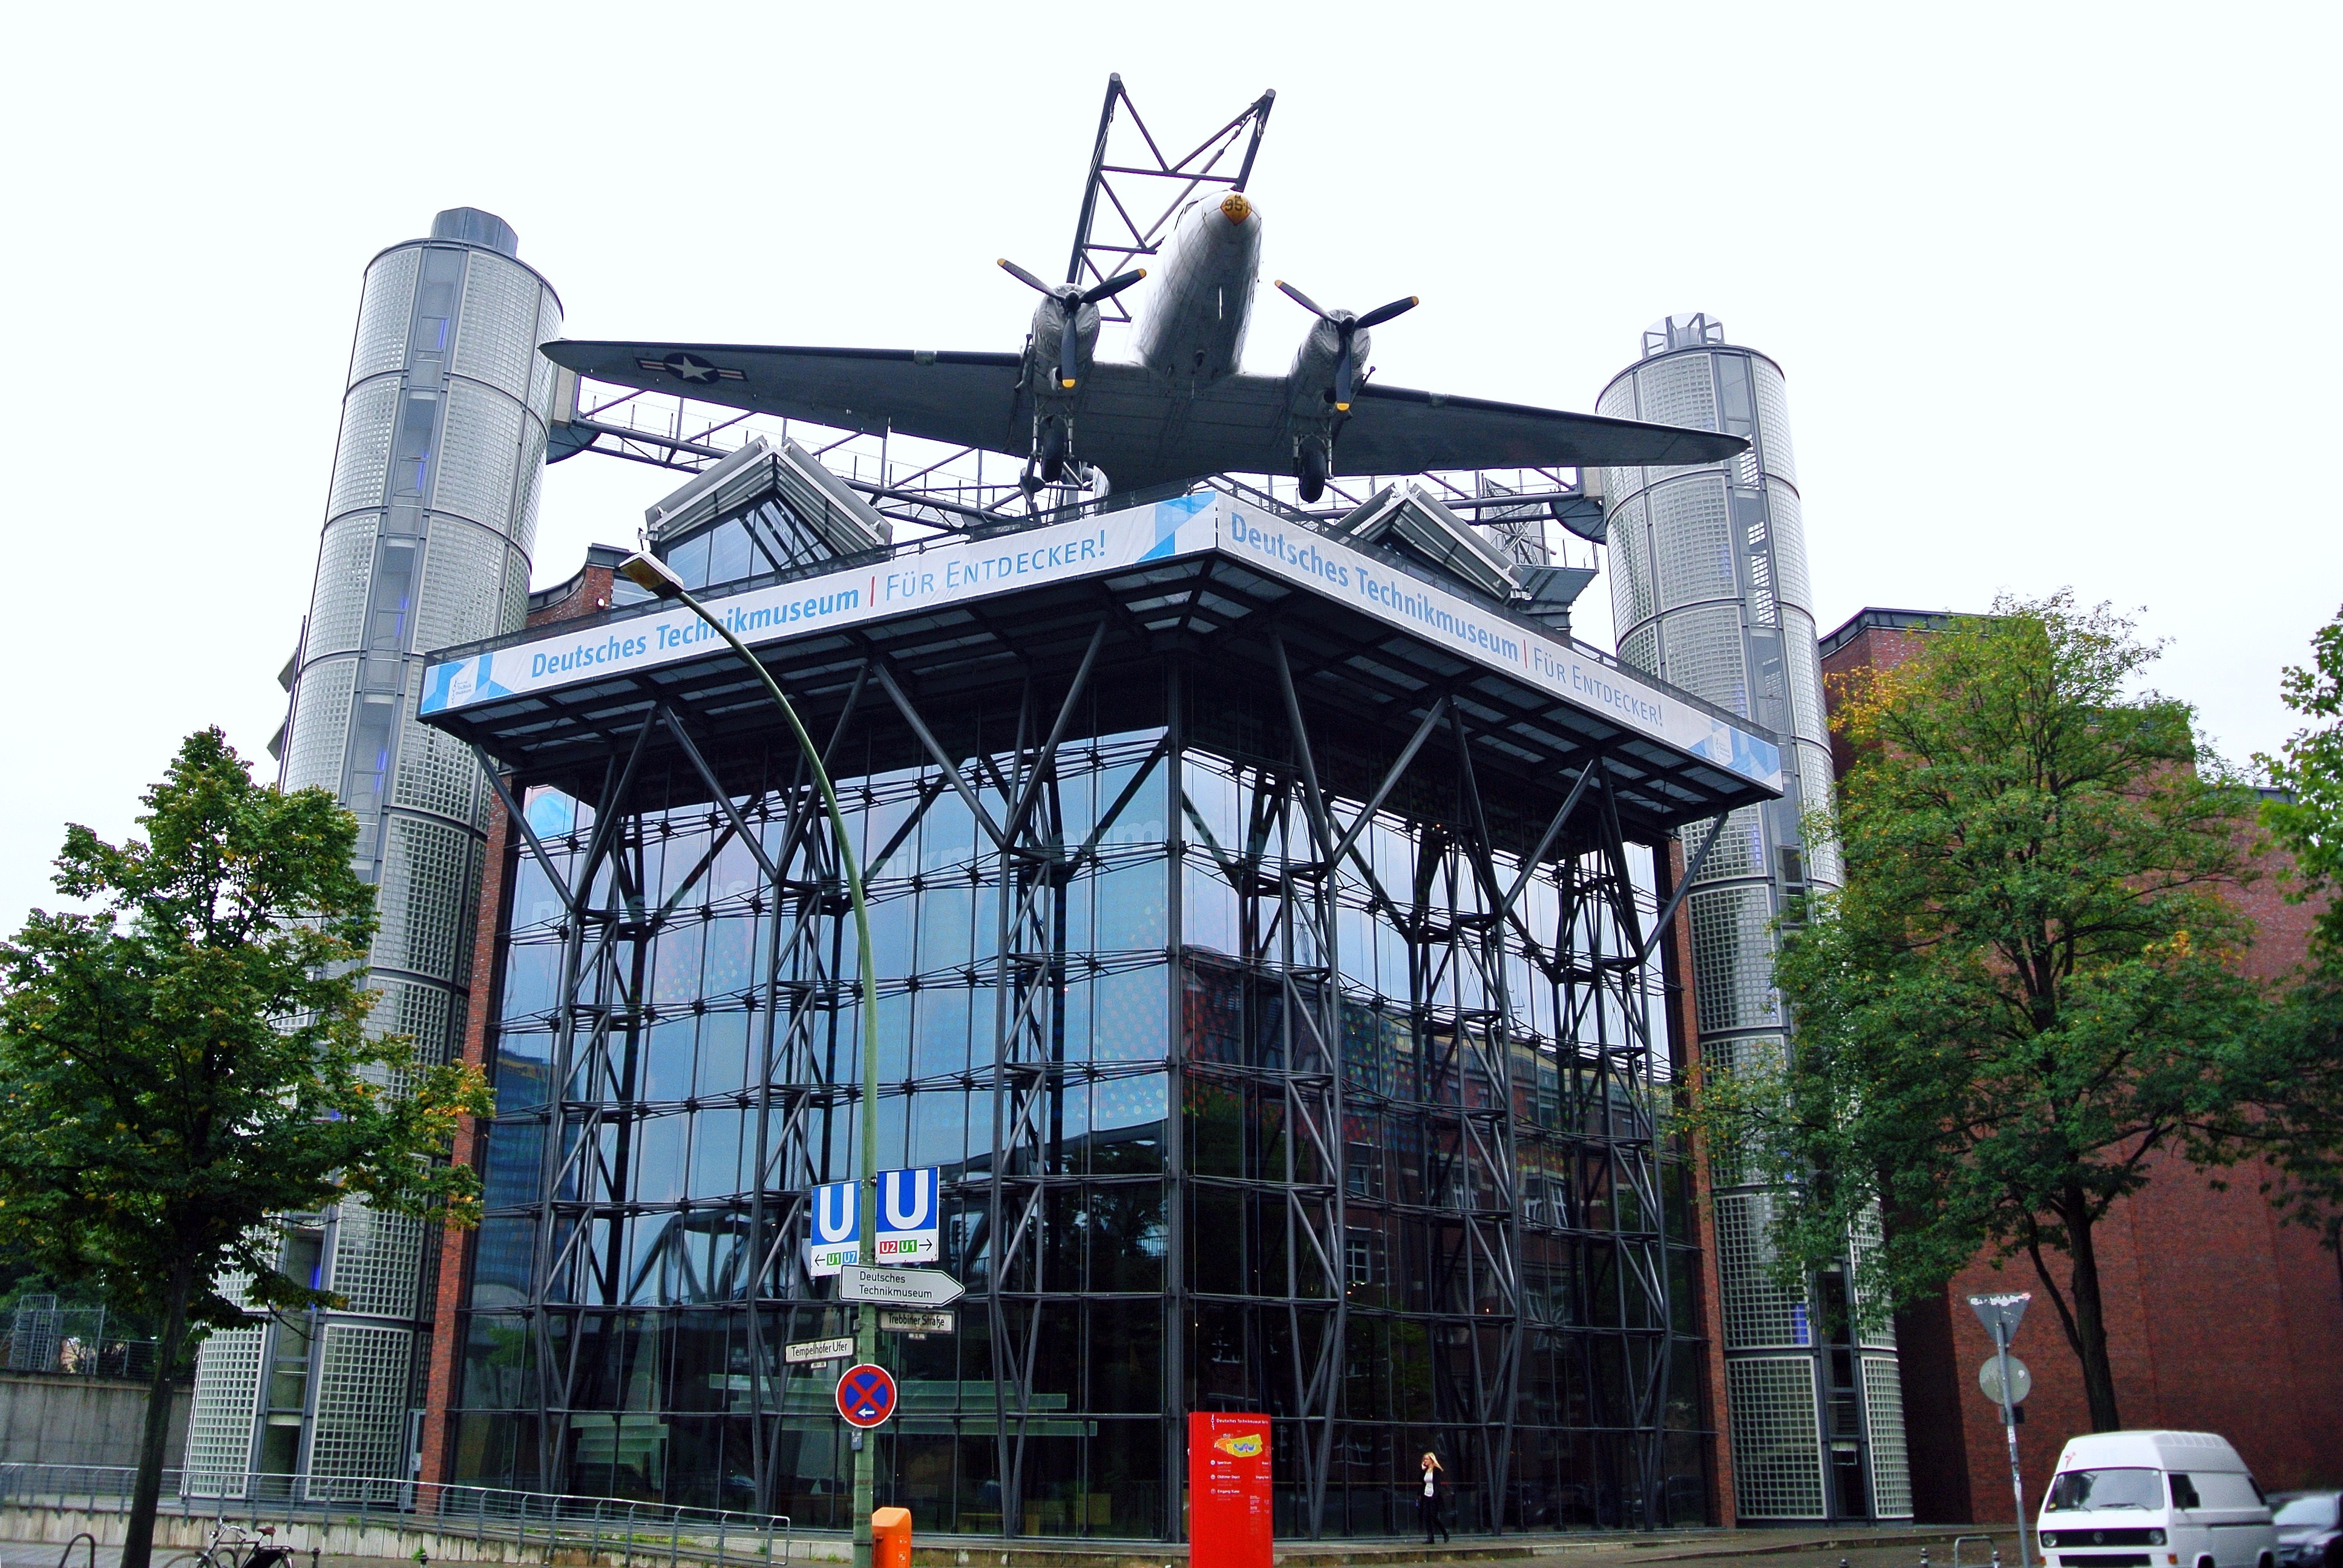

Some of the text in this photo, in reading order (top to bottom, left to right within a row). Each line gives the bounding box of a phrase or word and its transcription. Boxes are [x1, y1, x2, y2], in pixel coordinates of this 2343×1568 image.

[1231, 512, 1349, 587] Deutsches
[1355, 566, 1519, 662] Technikmuseum
[532, 635, 647, 678] Deutsches
[885, 1169, 929, 1230] U
[819, 1183, 854, 1243] U
[881, 1240, 916, 1253] U2 U1
[828, 1252, 856, 1264] U1 U7
[859, 1270, 906, 1284] Deutsches
[859, 1284, 932, 1299] Technikmuseum
[888, 1313, 945, 1328] Trebbiner Straße
[791, 1341, 848, 1358] Tempelhofer Ufer
